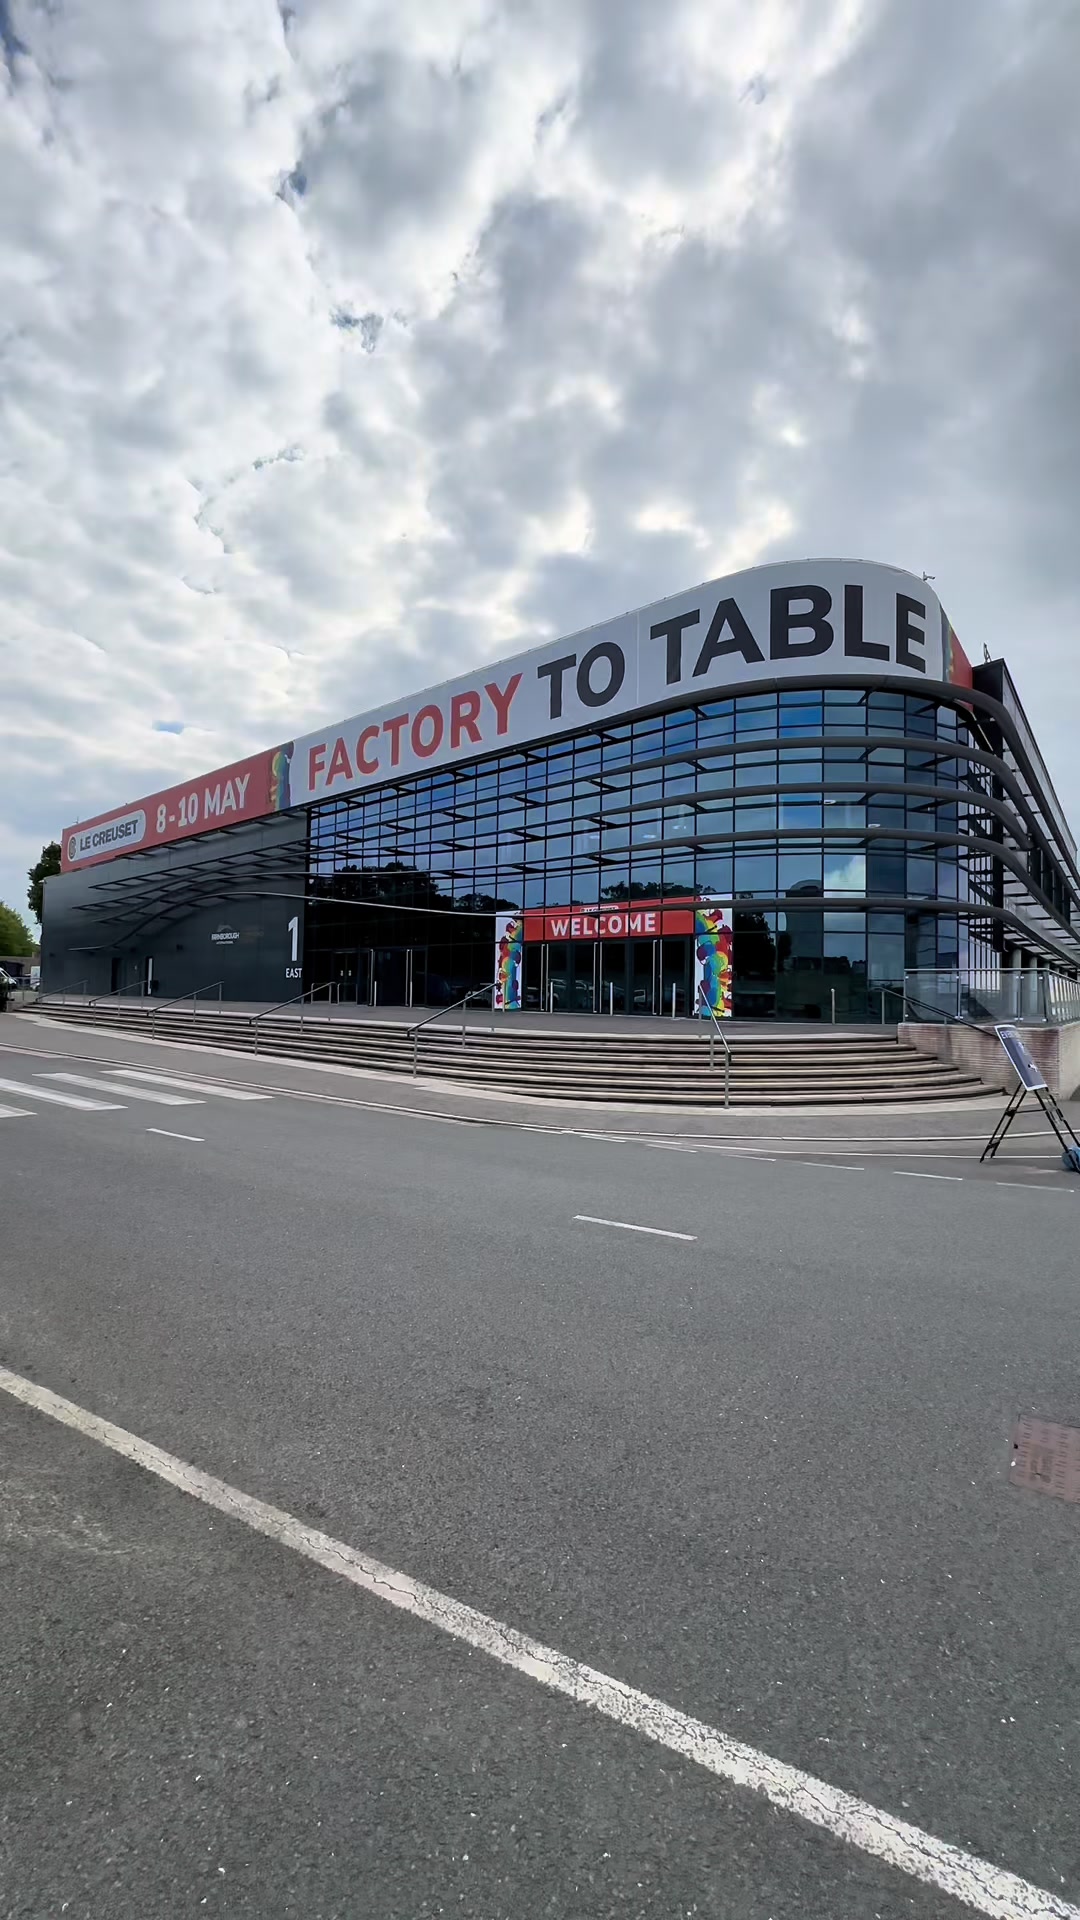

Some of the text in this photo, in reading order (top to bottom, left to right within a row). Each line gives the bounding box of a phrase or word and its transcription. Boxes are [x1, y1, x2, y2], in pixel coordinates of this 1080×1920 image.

[308, 584, 926, 791] FACTORY TO TABLE
[204, 773, 250, 819] MAY
[80, 820, 139, 851] LE CREUSET
[288, 916, 299, 962] 1
[550, 913, 656, 937] WELCOME
[286, 967, 303, 979] EAST
